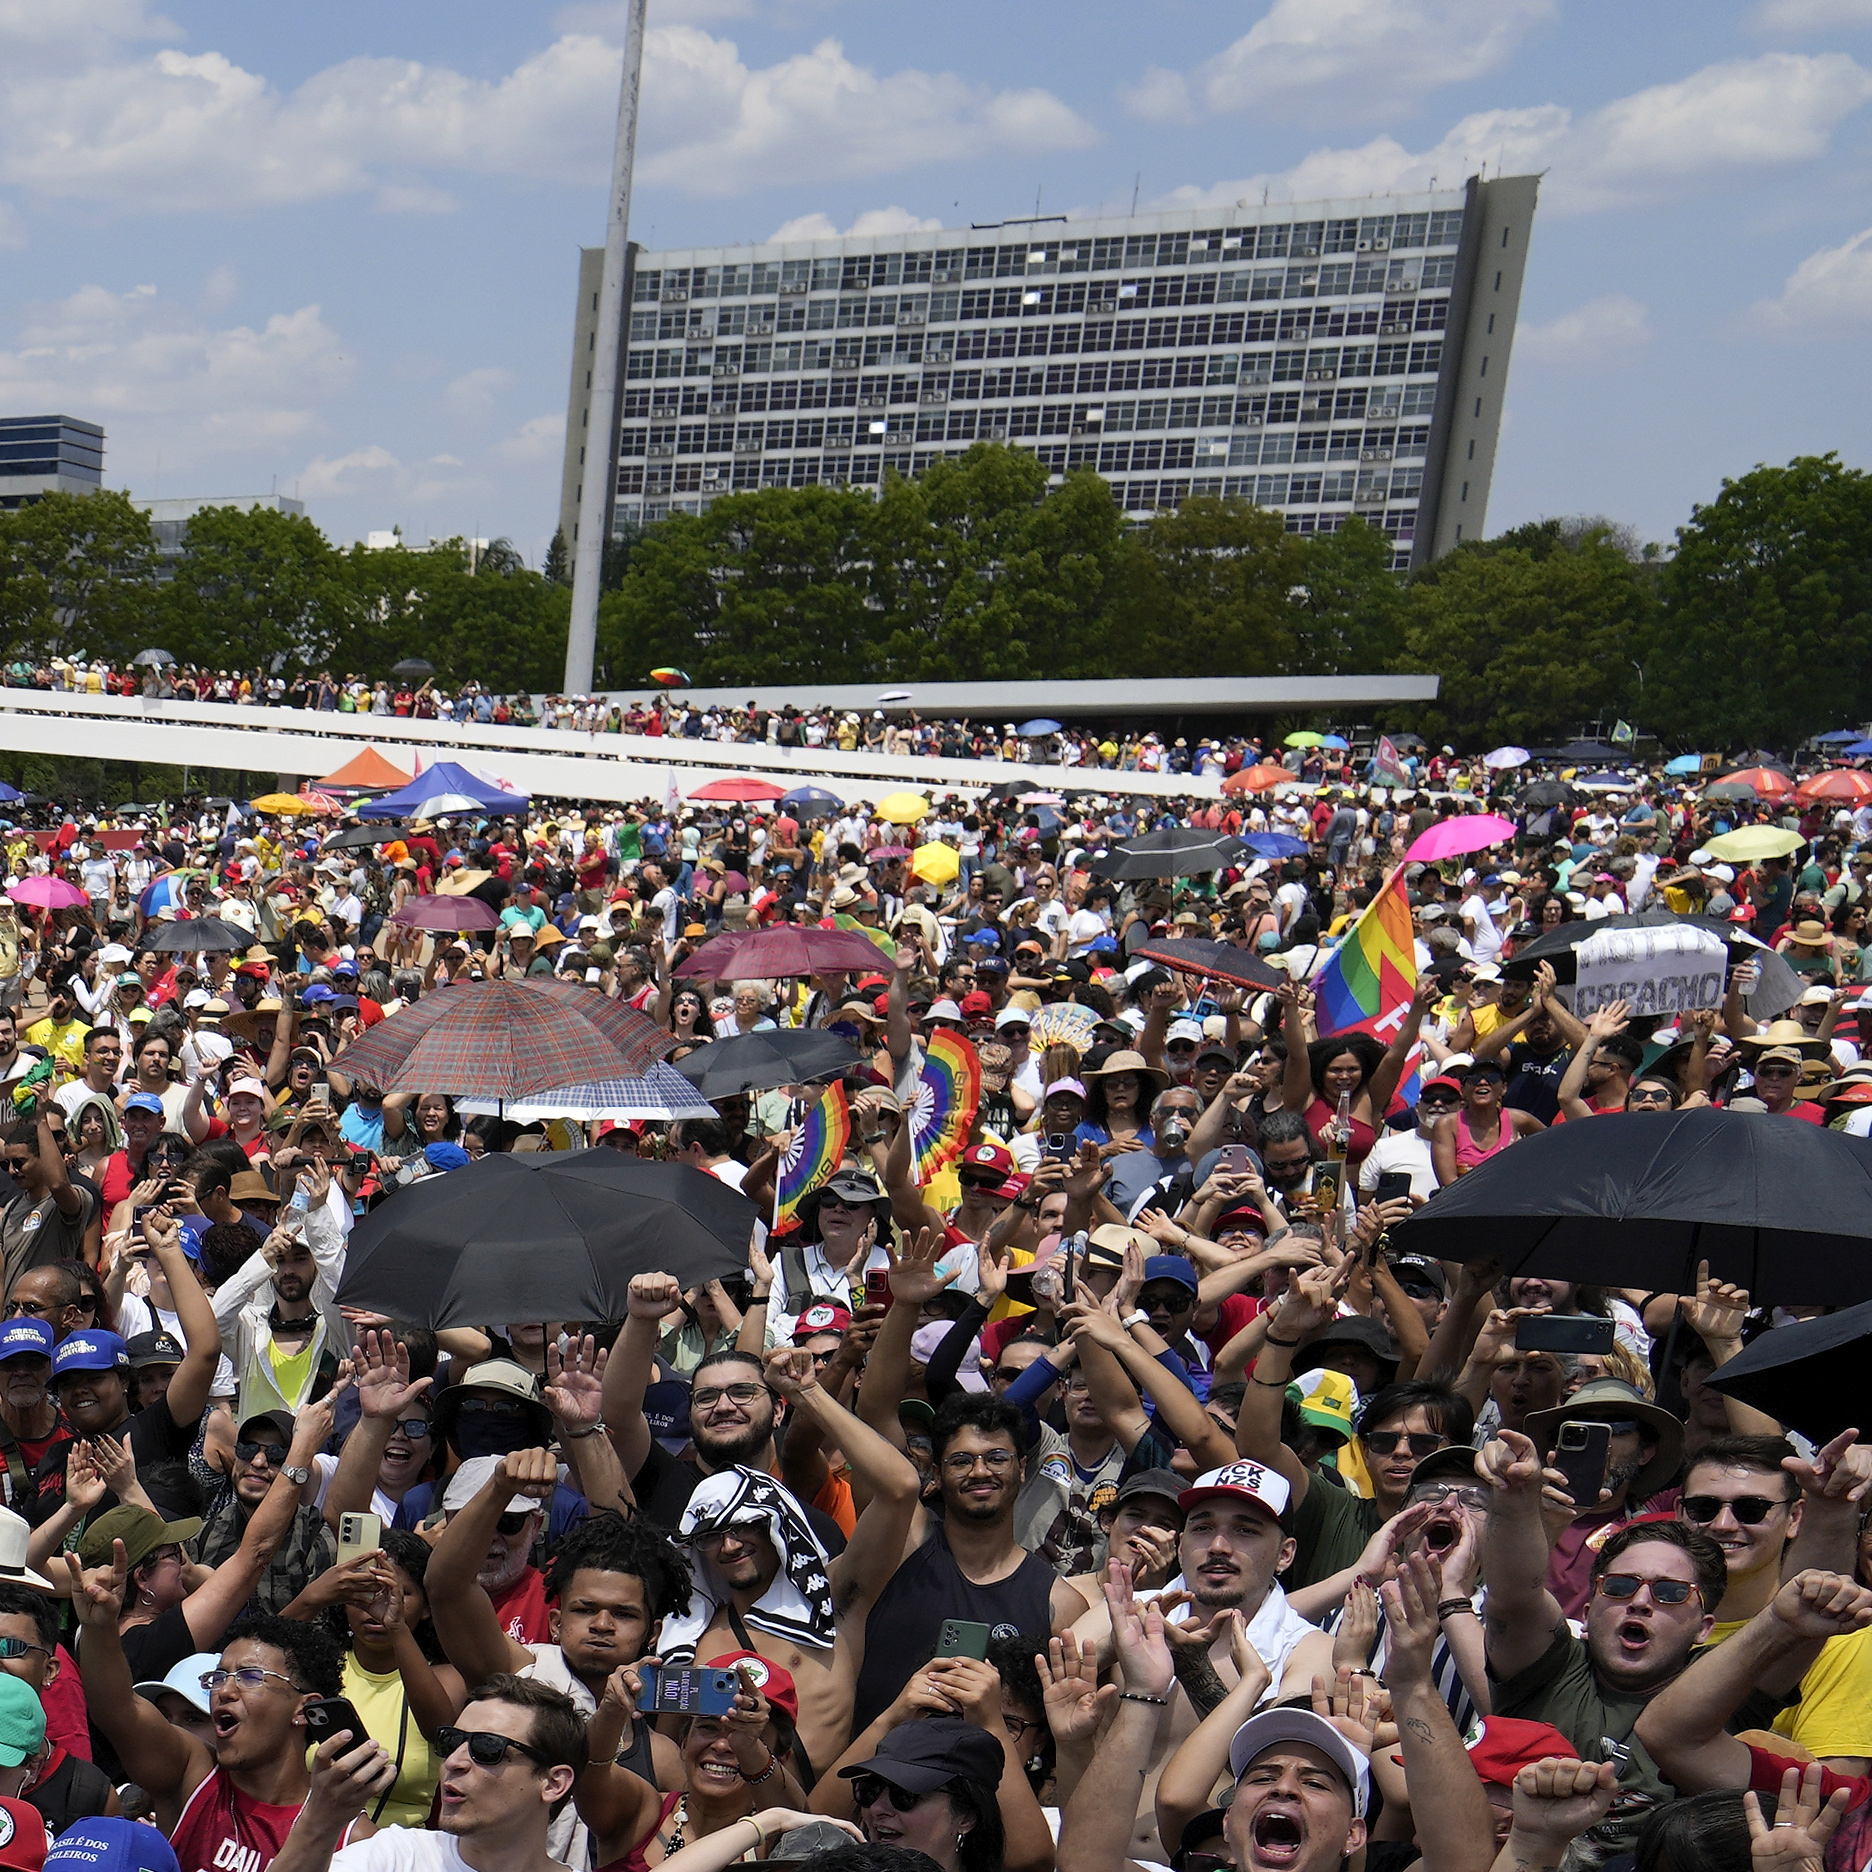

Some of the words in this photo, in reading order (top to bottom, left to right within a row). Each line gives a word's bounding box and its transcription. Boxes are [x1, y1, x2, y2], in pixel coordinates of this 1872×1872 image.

[2, 1334, 47, 1345] SOBERANO
[10, 1328, 40, 1338] BRASIL
[59, 1339, 88, 1354] BRASIL
[1218, 1464, 1266, 1484] FCK
[1214, 1474, 1262, 1490] NZS
[85, 1839, 110, 1851] DOS
